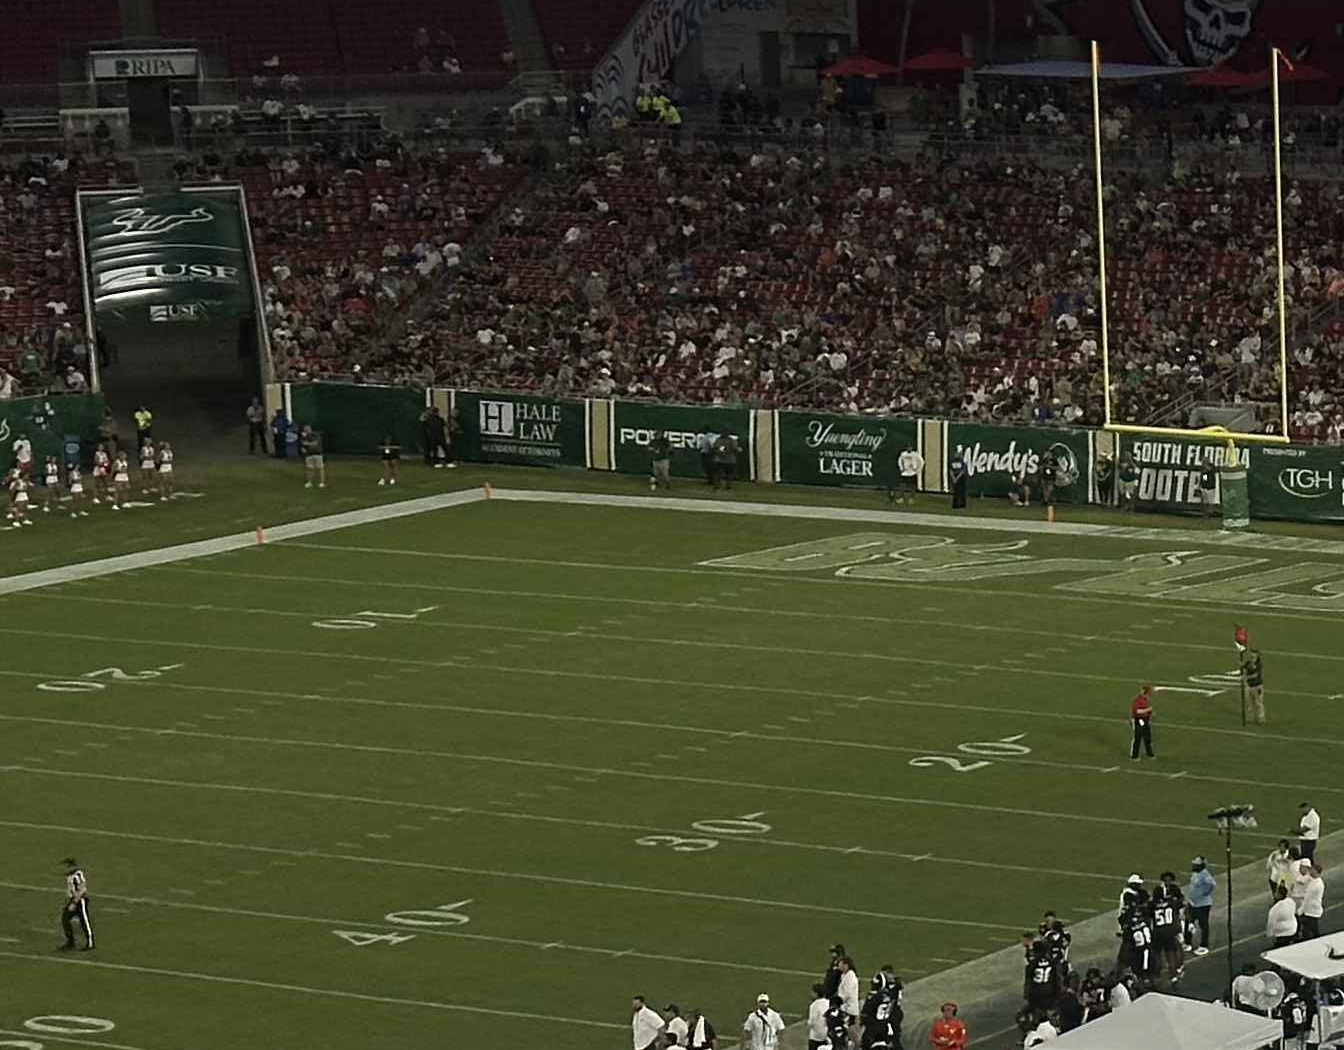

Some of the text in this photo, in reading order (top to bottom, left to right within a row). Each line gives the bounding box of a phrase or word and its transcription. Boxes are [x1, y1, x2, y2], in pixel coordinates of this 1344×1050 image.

[132, 60, 176, 74] RIPA
[515, 403, 562, 423] HALE
[519, 421, 559, 441] LAW
[805, 419, 888, 450] Yuengling
[957, 441, 1040, 479] Wendy's
[1133, 441, 1183, 465] SOUTH
[818, 458, 874, 477] LAGER
[1285, 467, 1334, 490] TGH
[909, 737, 1032, 773] 20
[636, 817, 772, 853] 30
[332, 909, 470, 946] 40
